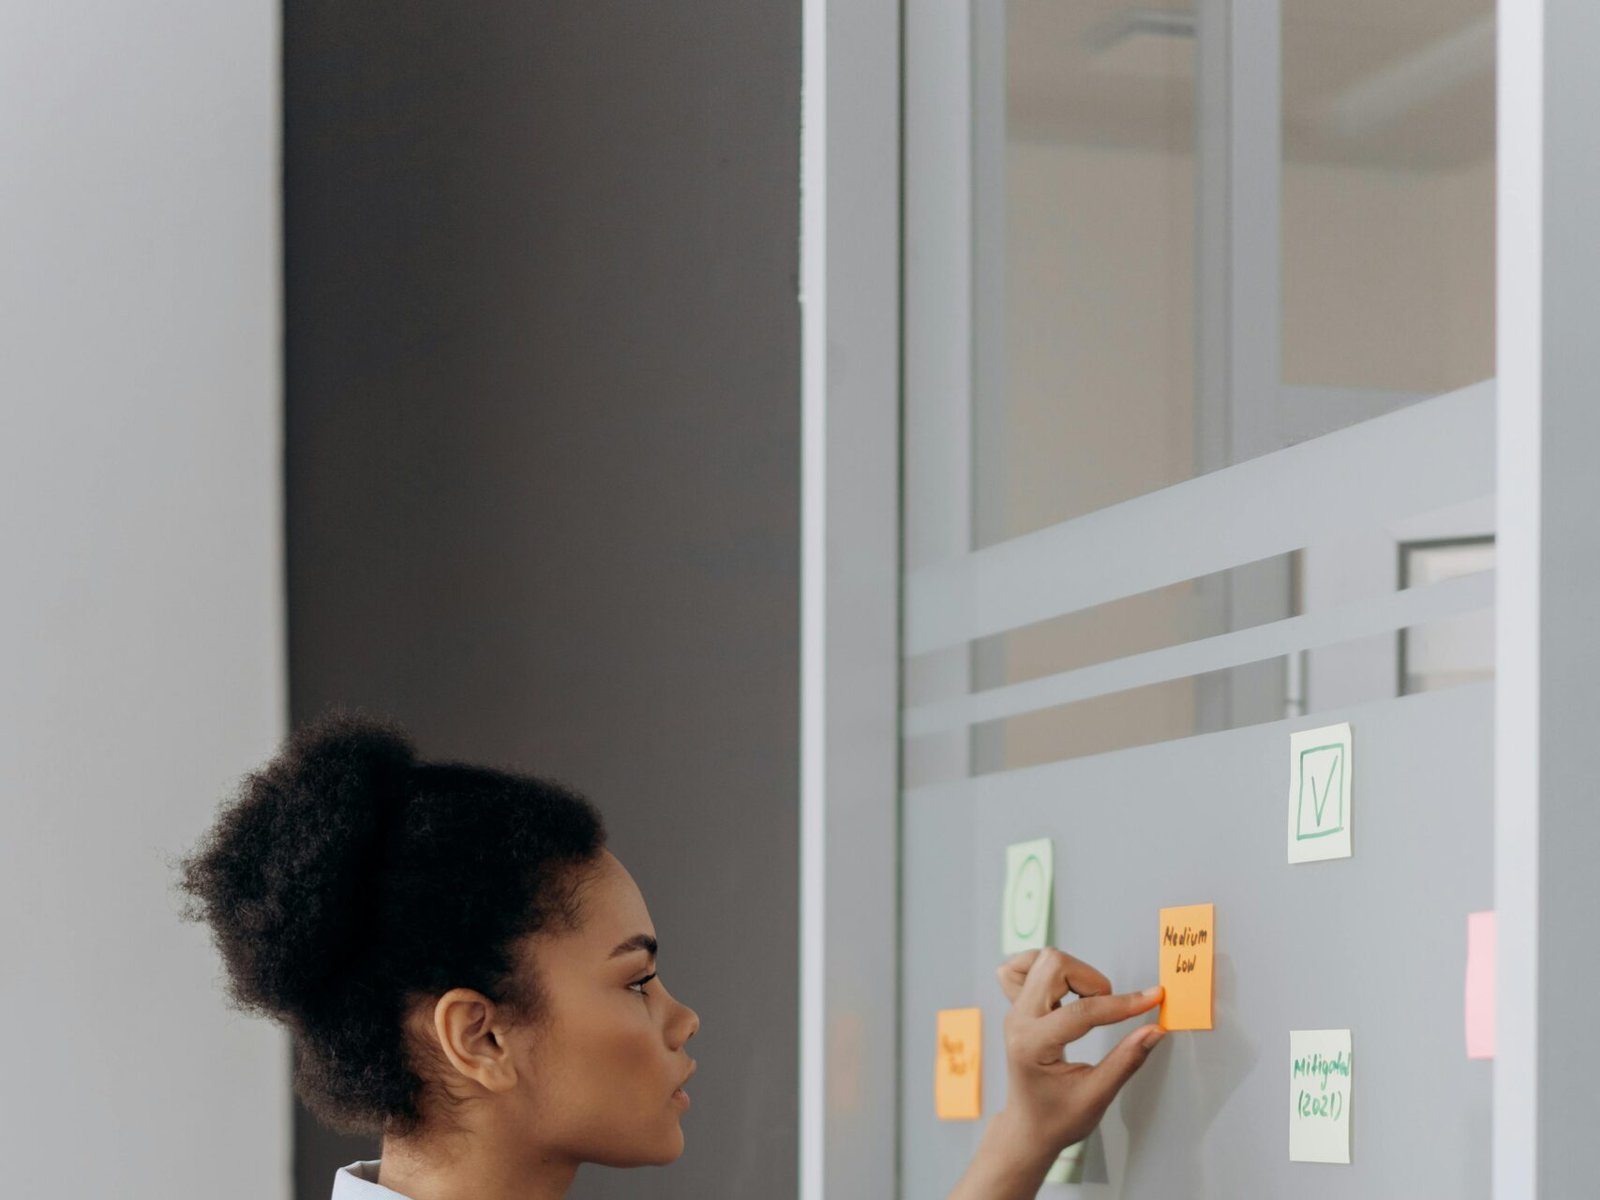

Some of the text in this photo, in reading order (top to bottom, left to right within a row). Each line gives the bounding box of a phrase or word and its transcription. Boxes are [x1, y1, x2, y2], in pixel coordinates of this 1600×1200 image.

[1163, 925, 1207, 947] Medium
[1176, 953, 1197, 974] Low
[1298, 1089, 1342, 1122] (2021)
